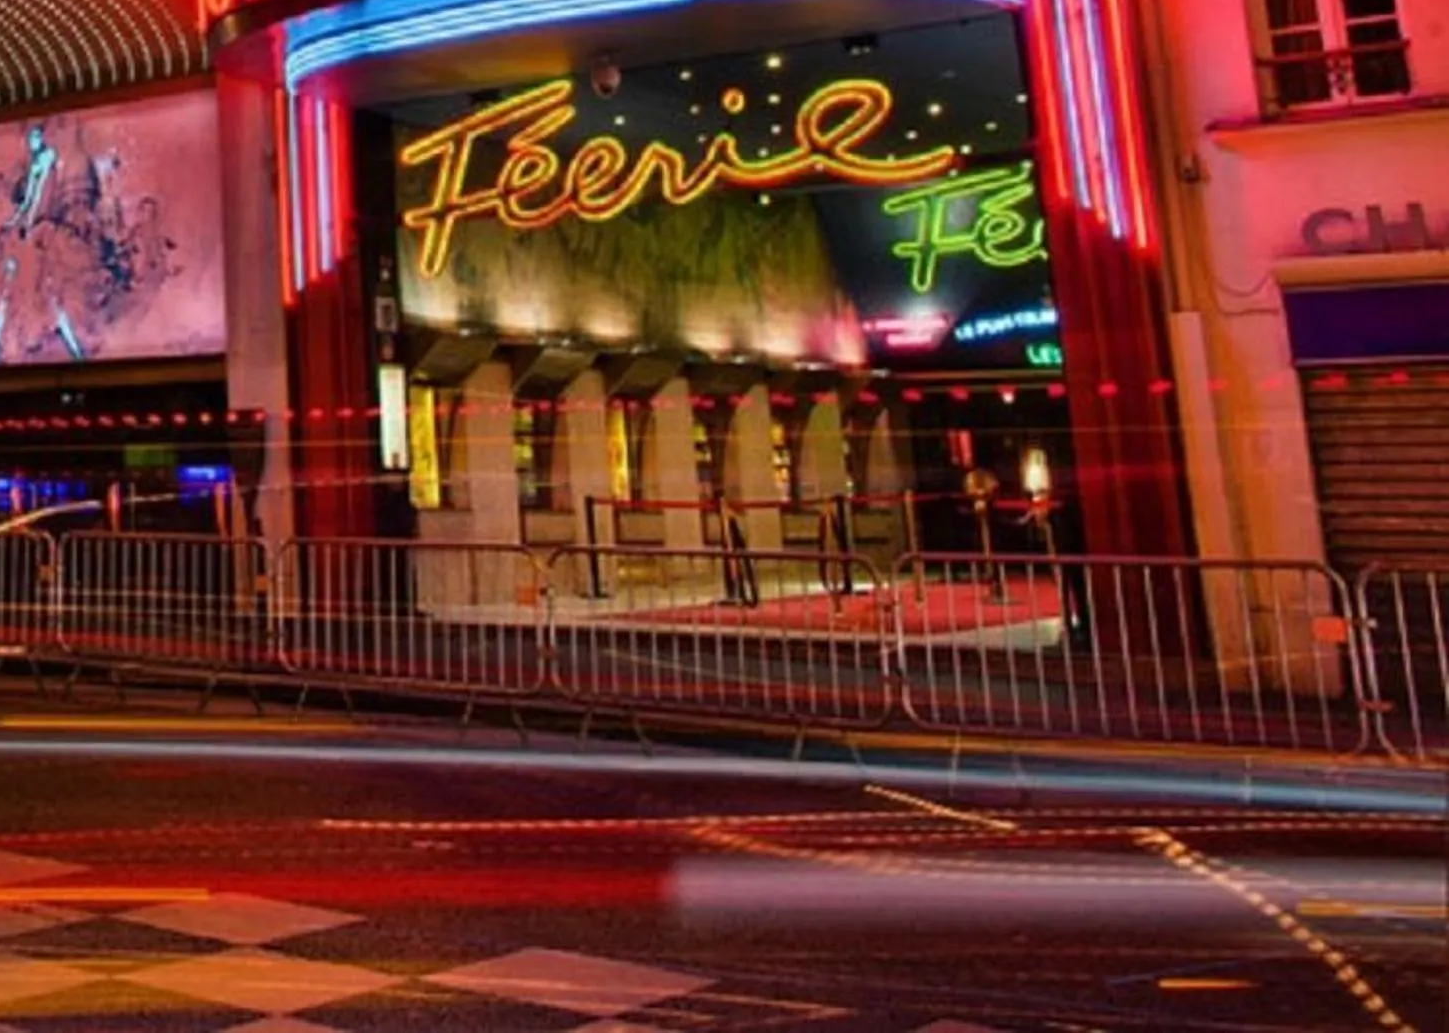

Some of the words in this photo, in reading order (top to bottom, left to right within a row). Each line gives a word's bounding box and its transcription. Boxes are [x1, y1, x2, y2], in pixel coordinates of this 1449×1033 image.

[399, 77, 956, 279] Féerie
[882, 160, 1048, 292] Fé
[1301, 201, 1449, 257] CH
